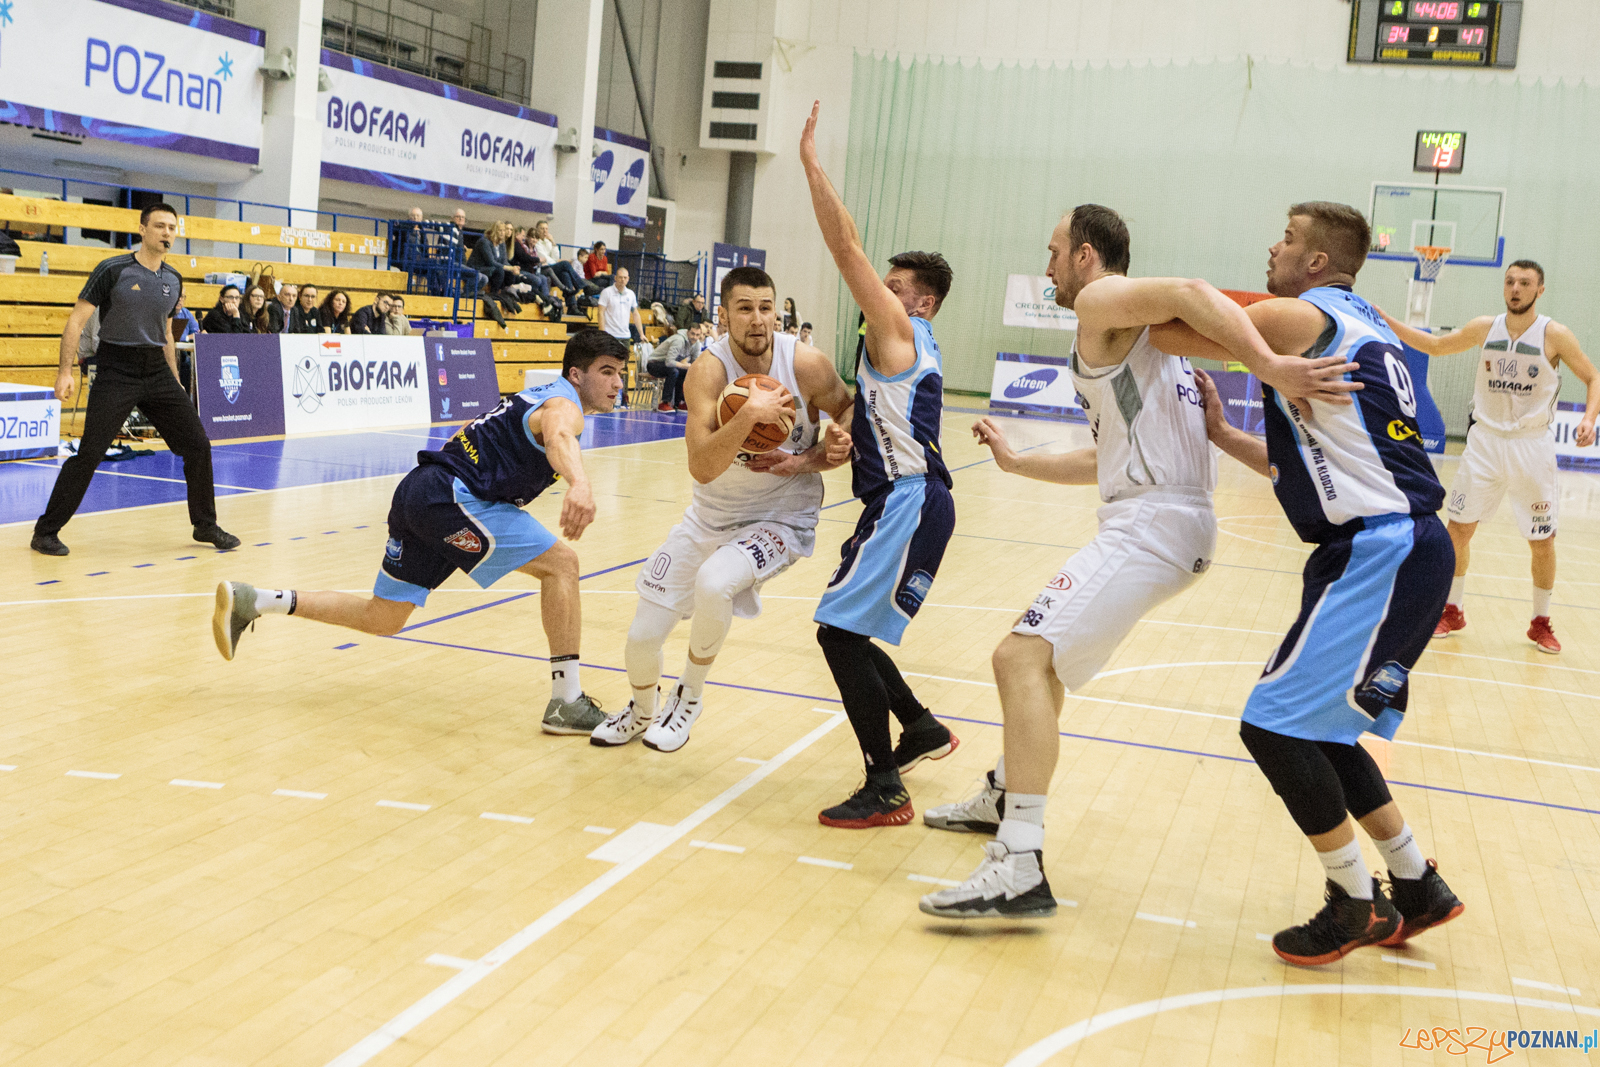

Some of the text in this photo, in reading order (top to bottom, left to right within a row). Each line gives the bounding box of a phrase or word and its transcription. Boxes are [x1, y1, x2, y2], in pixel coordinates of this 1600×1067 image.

[1387, 25, 1410, 43] 34
[1461, 28, 1484, 45] 47
[327, 96, 535, 172] BIOFARM BIOFARM
[1422, 132, 1461, 150] 44:06
[335, 136, 417, 161] POLSKI PRODUCENT LEKÓW
[1432, 146, 1454, 168] 13
[466, 163, 483, 175] POLSKI
[328, 359, 418, 391] BIOFARM
[1497, 357, 1518, 379] 14
[1012, 376, 1048, 390] atrem
[1489, 379, 1532, 392] BIOFARM
[337, 395, 413, 406] POLSKI PRODUCENT LEKÓW
[1228, 397, 1264, 408] www.bas
[1316, 464, 1338, 501] KŁODZKO
[746, 544, 767, 570] PBG
